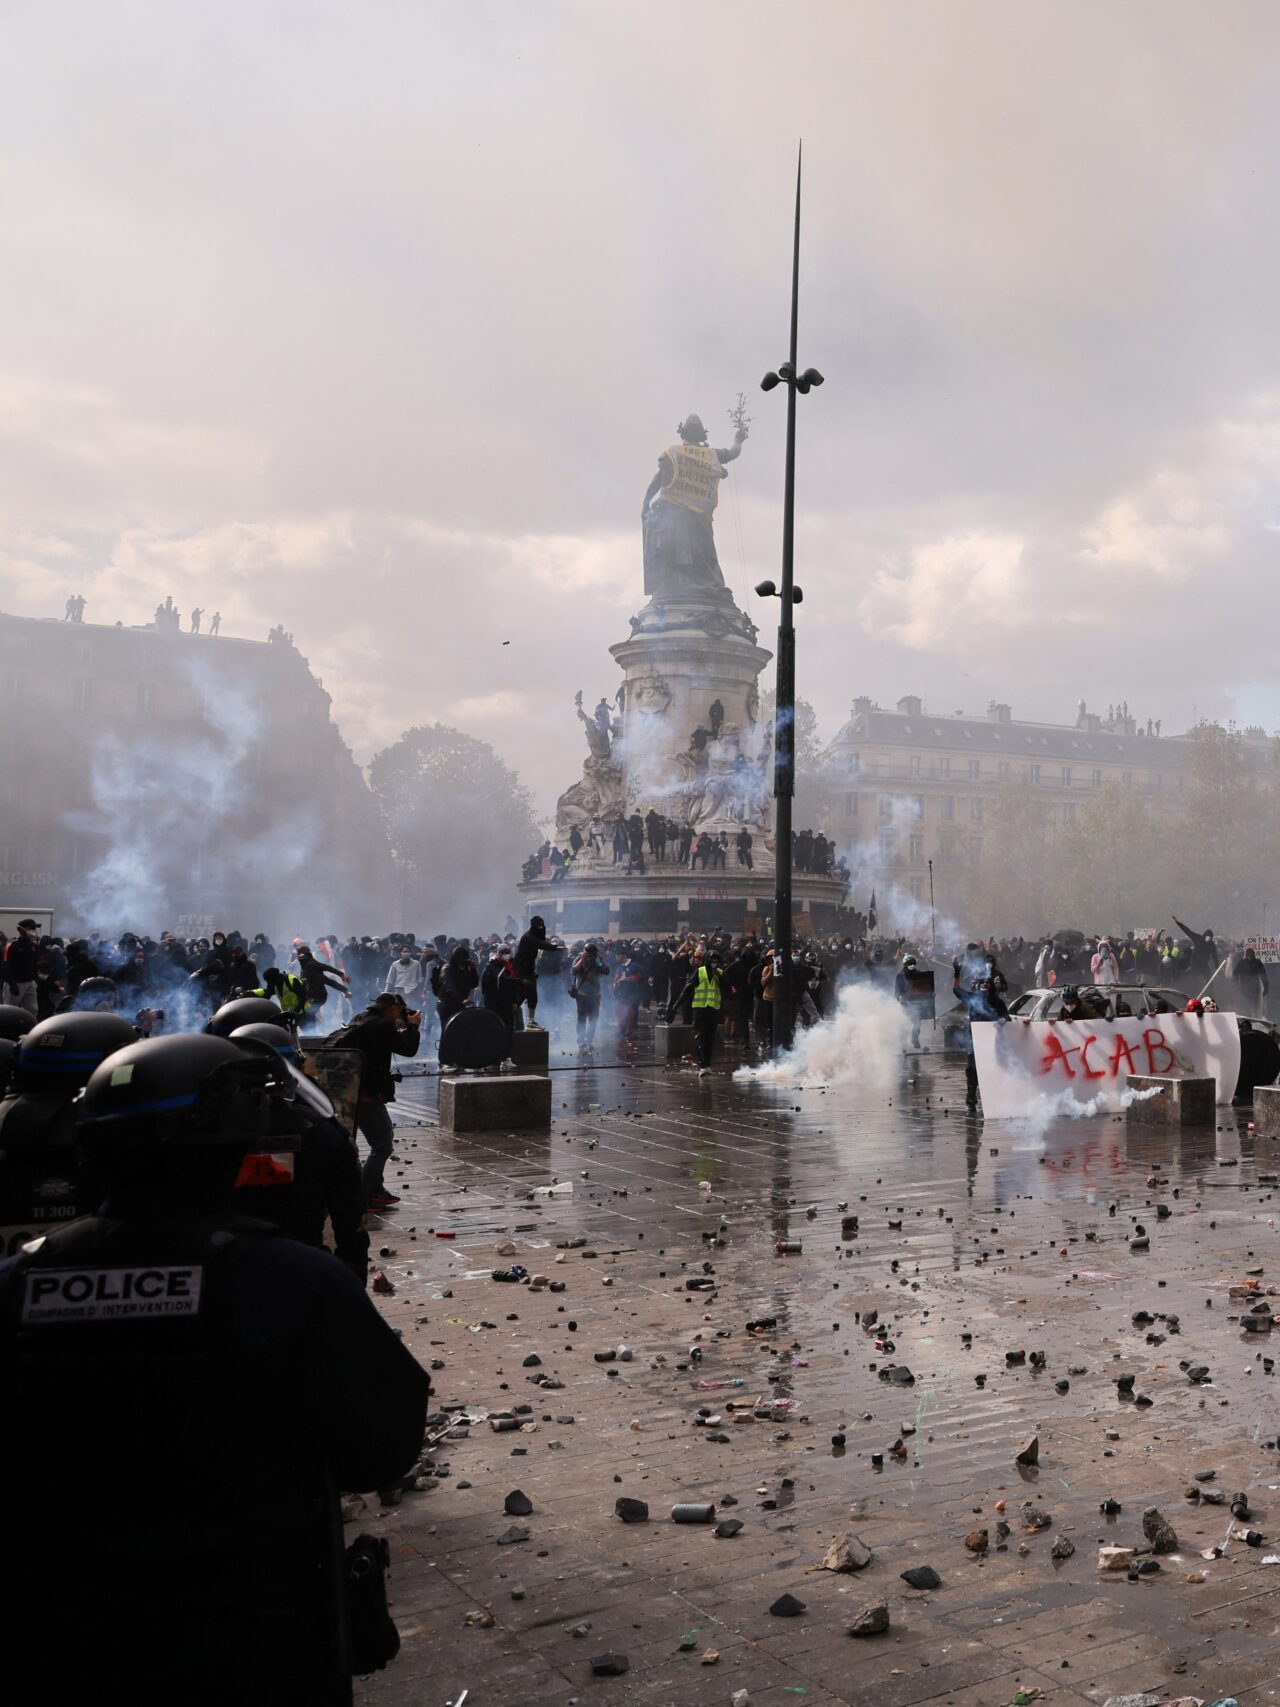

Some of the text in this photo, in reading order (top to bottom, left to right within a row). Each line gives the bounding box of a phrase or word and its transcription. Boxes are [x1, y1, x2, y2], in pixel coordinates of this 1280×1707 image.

[178, 914, 215, 925] FIVE
[176, 925, 216, 936] GUYS
[1040, 1028, 1174, 1079] ACAB
[49, 1206, 76, 1217] 300
[31, 1271, 192, 1304] POLICE
[103, 1300, 192, 1314] INTERVENTION
